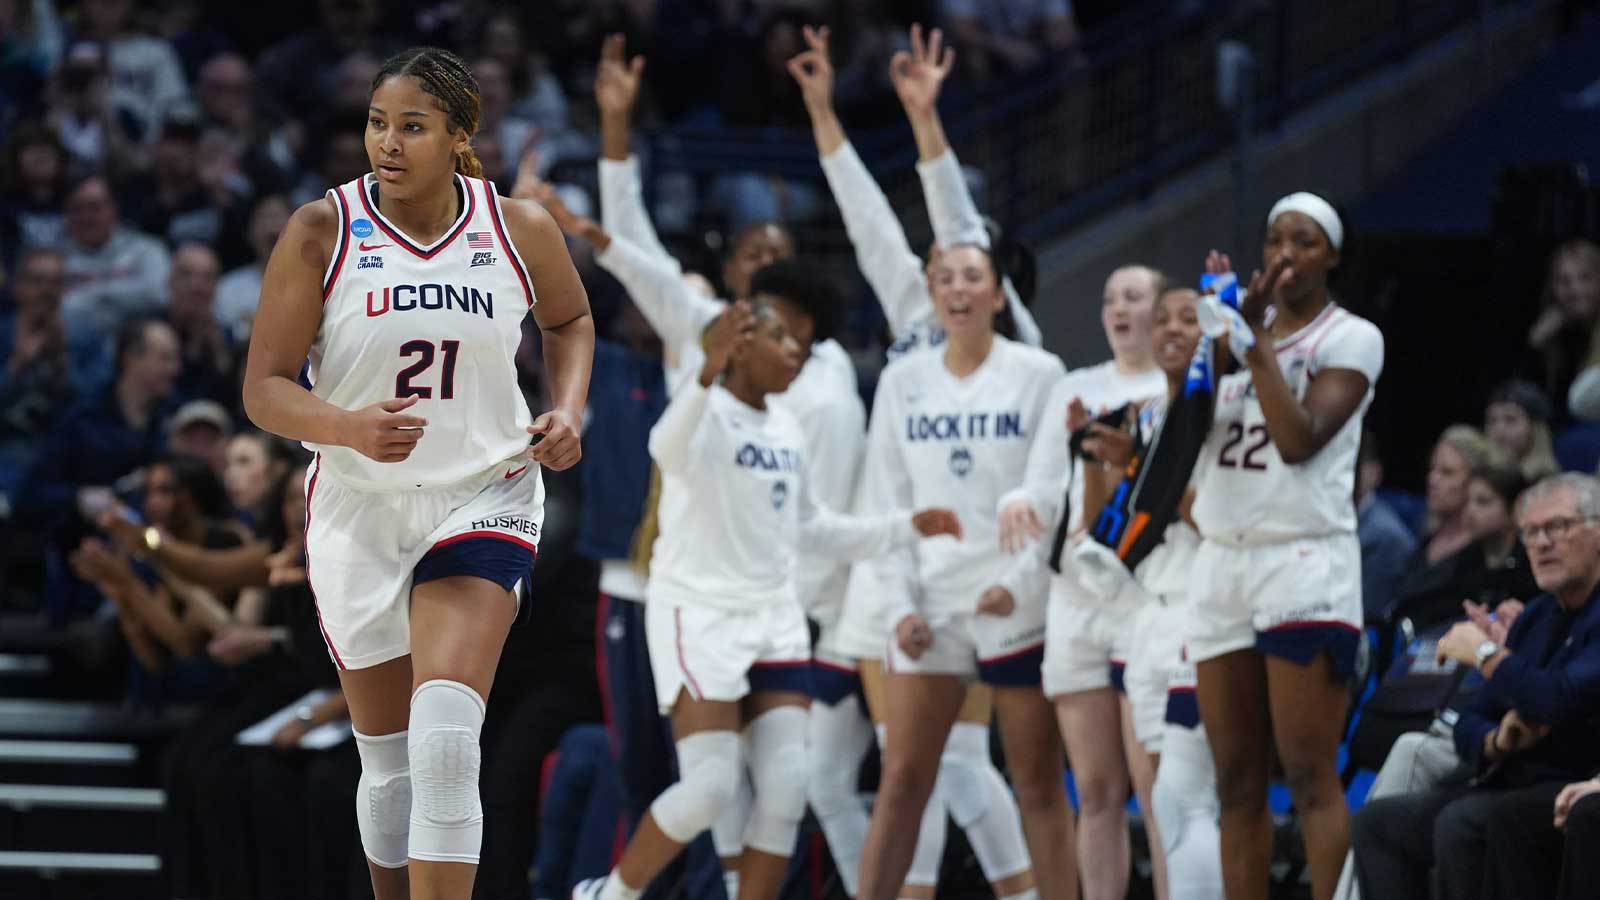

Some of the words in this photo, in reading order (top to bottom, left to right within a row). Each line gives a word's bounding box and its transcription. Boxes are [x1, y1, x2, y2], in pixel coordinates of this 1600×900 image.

[357, 262, 384, 270] CHANGE
[471, 257, 497, 265] EAST
[366, 283, 494, 320] UCONN
[395, 339, 460, 400] 21
[907, 413, 962, 440] LOCK
[967, 413, 989, 438] IT
[1218, 420, 1271, 471] 22
[472, 516, 538, 536] HUSKIES
